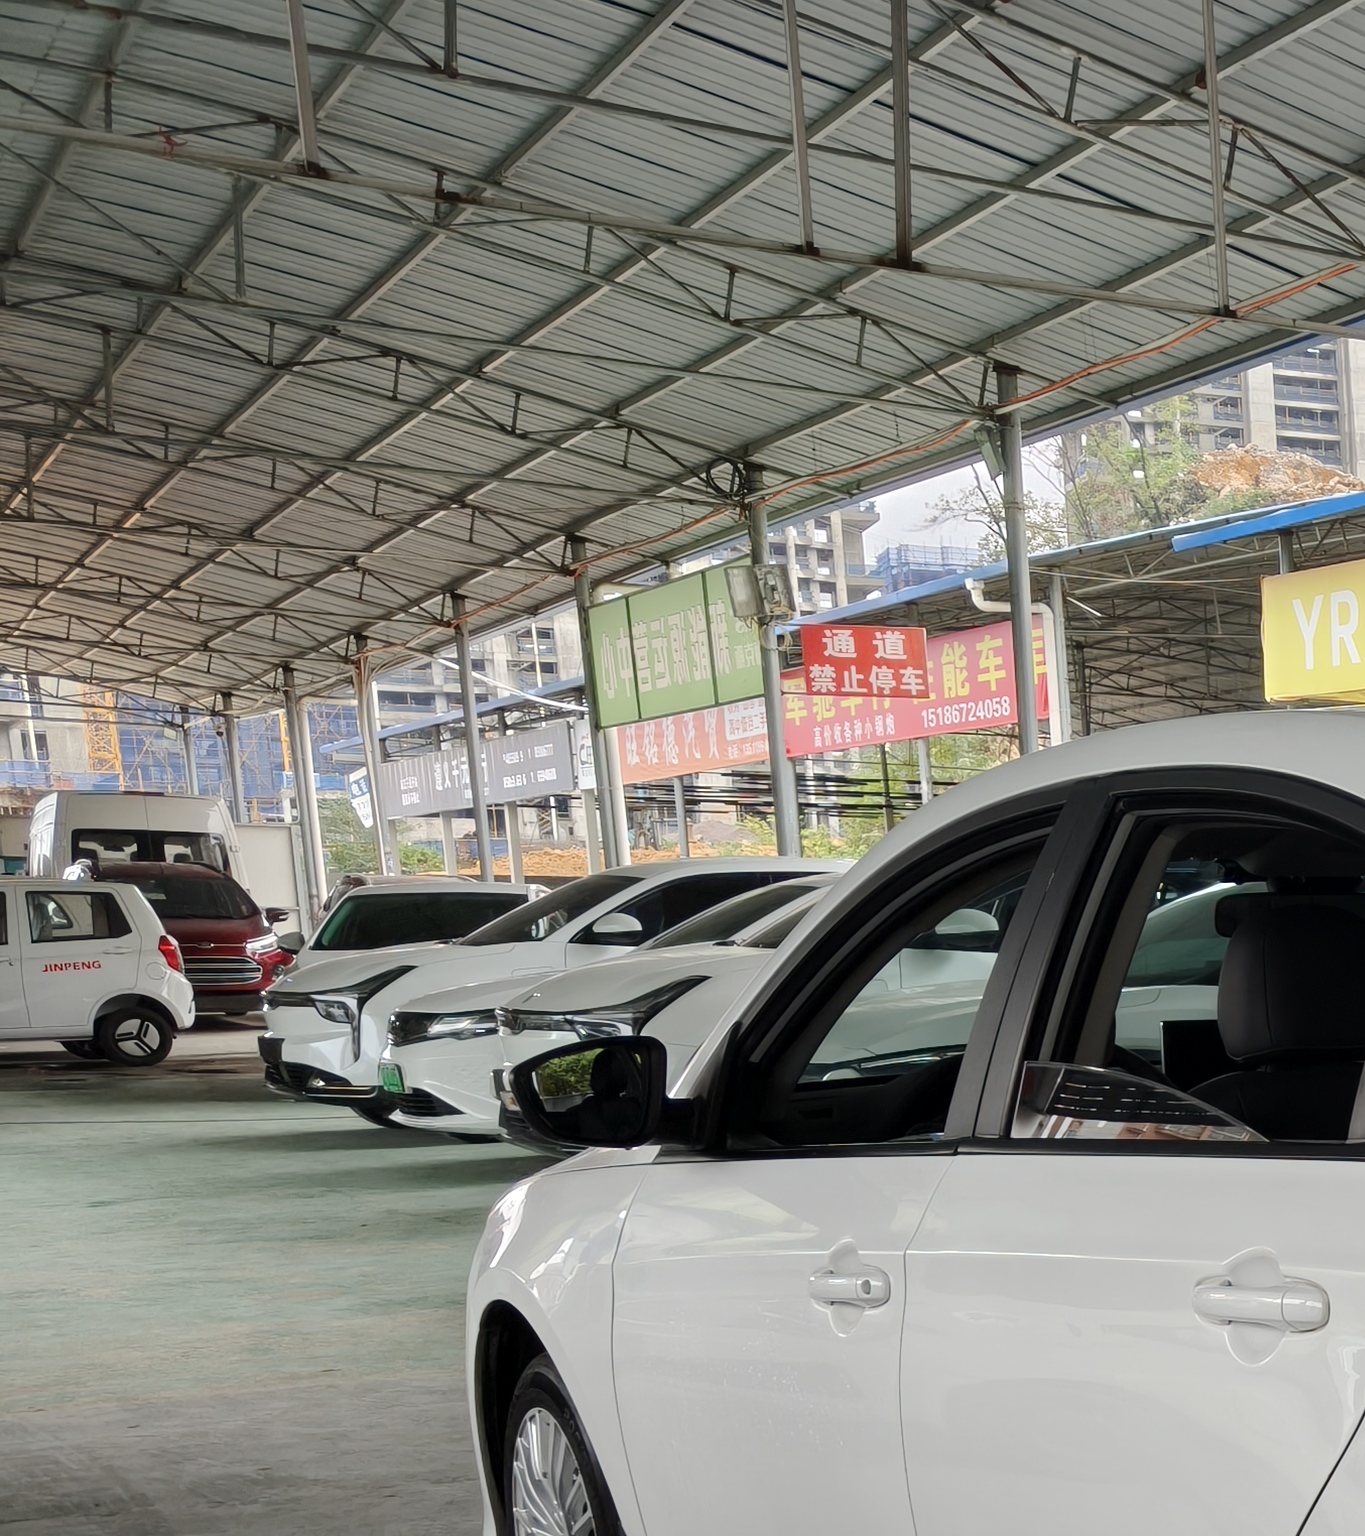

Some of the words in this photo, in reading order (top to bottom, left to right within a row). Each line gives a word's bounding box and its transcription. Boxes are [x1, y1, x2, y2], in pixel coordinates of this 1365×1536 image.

[822, 629, 907, 660] 通道
[809, 663, 926, 697] 禁止停车
[920, 695, 1011, 729] 15186724058
[42, 960, 102, 973] JINPENG
